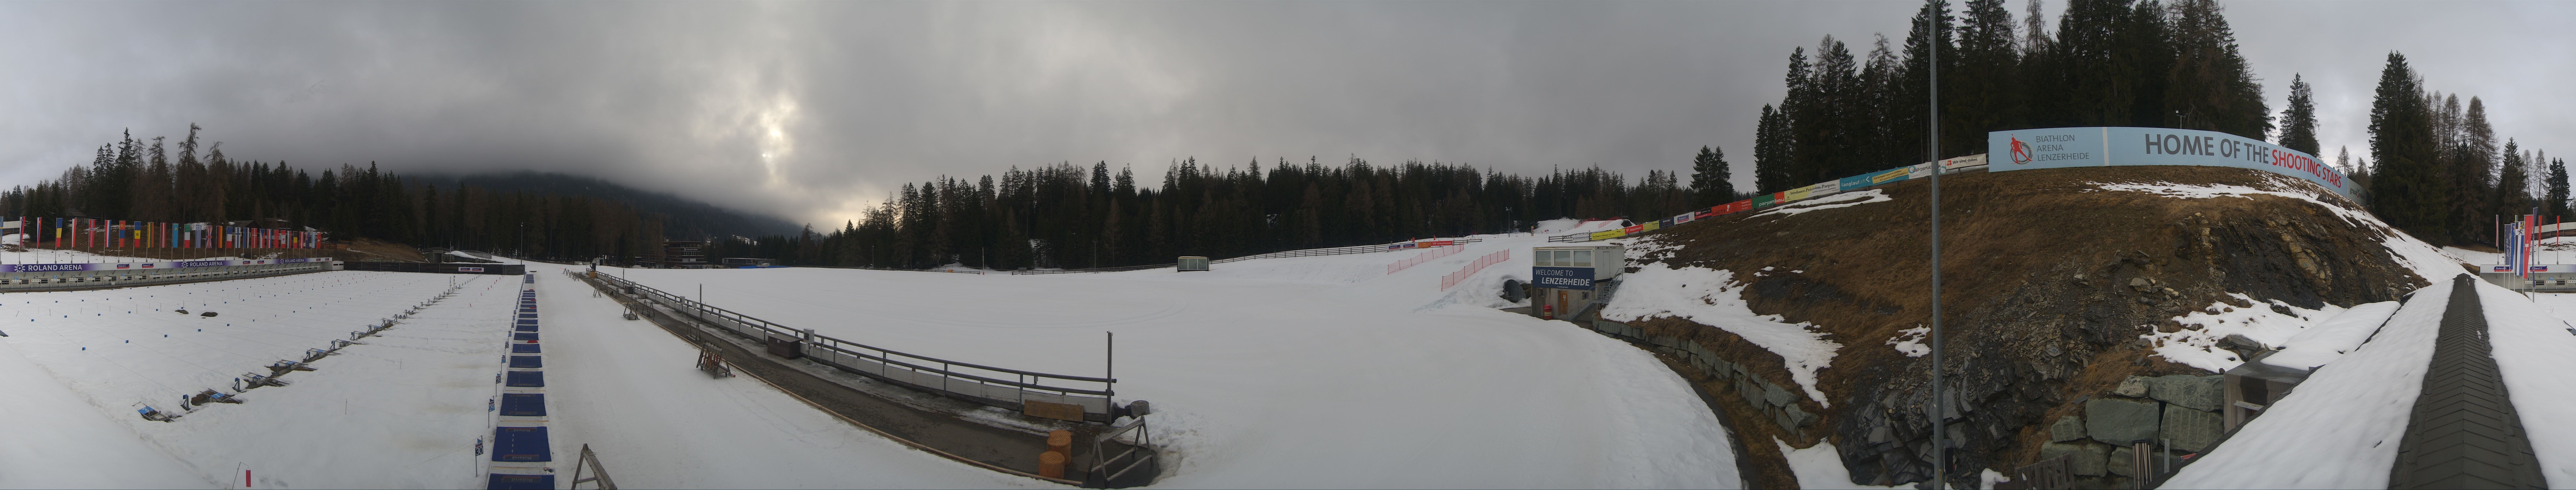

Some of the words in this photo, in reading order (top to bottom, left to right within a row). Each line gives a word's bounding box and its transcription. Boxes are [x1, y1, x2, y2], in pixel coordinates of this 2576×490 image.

[2145, 134, 2214, 156] HOME
[2221, 139, 2240, 159] OF
[2244, 143, 2268, 164] THE
[2272, 149, 2320, 177] SHOOTING
[2323, 167, 2341, 188] STARS
[1759, 198, 1784, 207] parpanbau
[1541, 277, 1590, 286] LENZERHEIDE
[476, 447, 483, 455] 30
